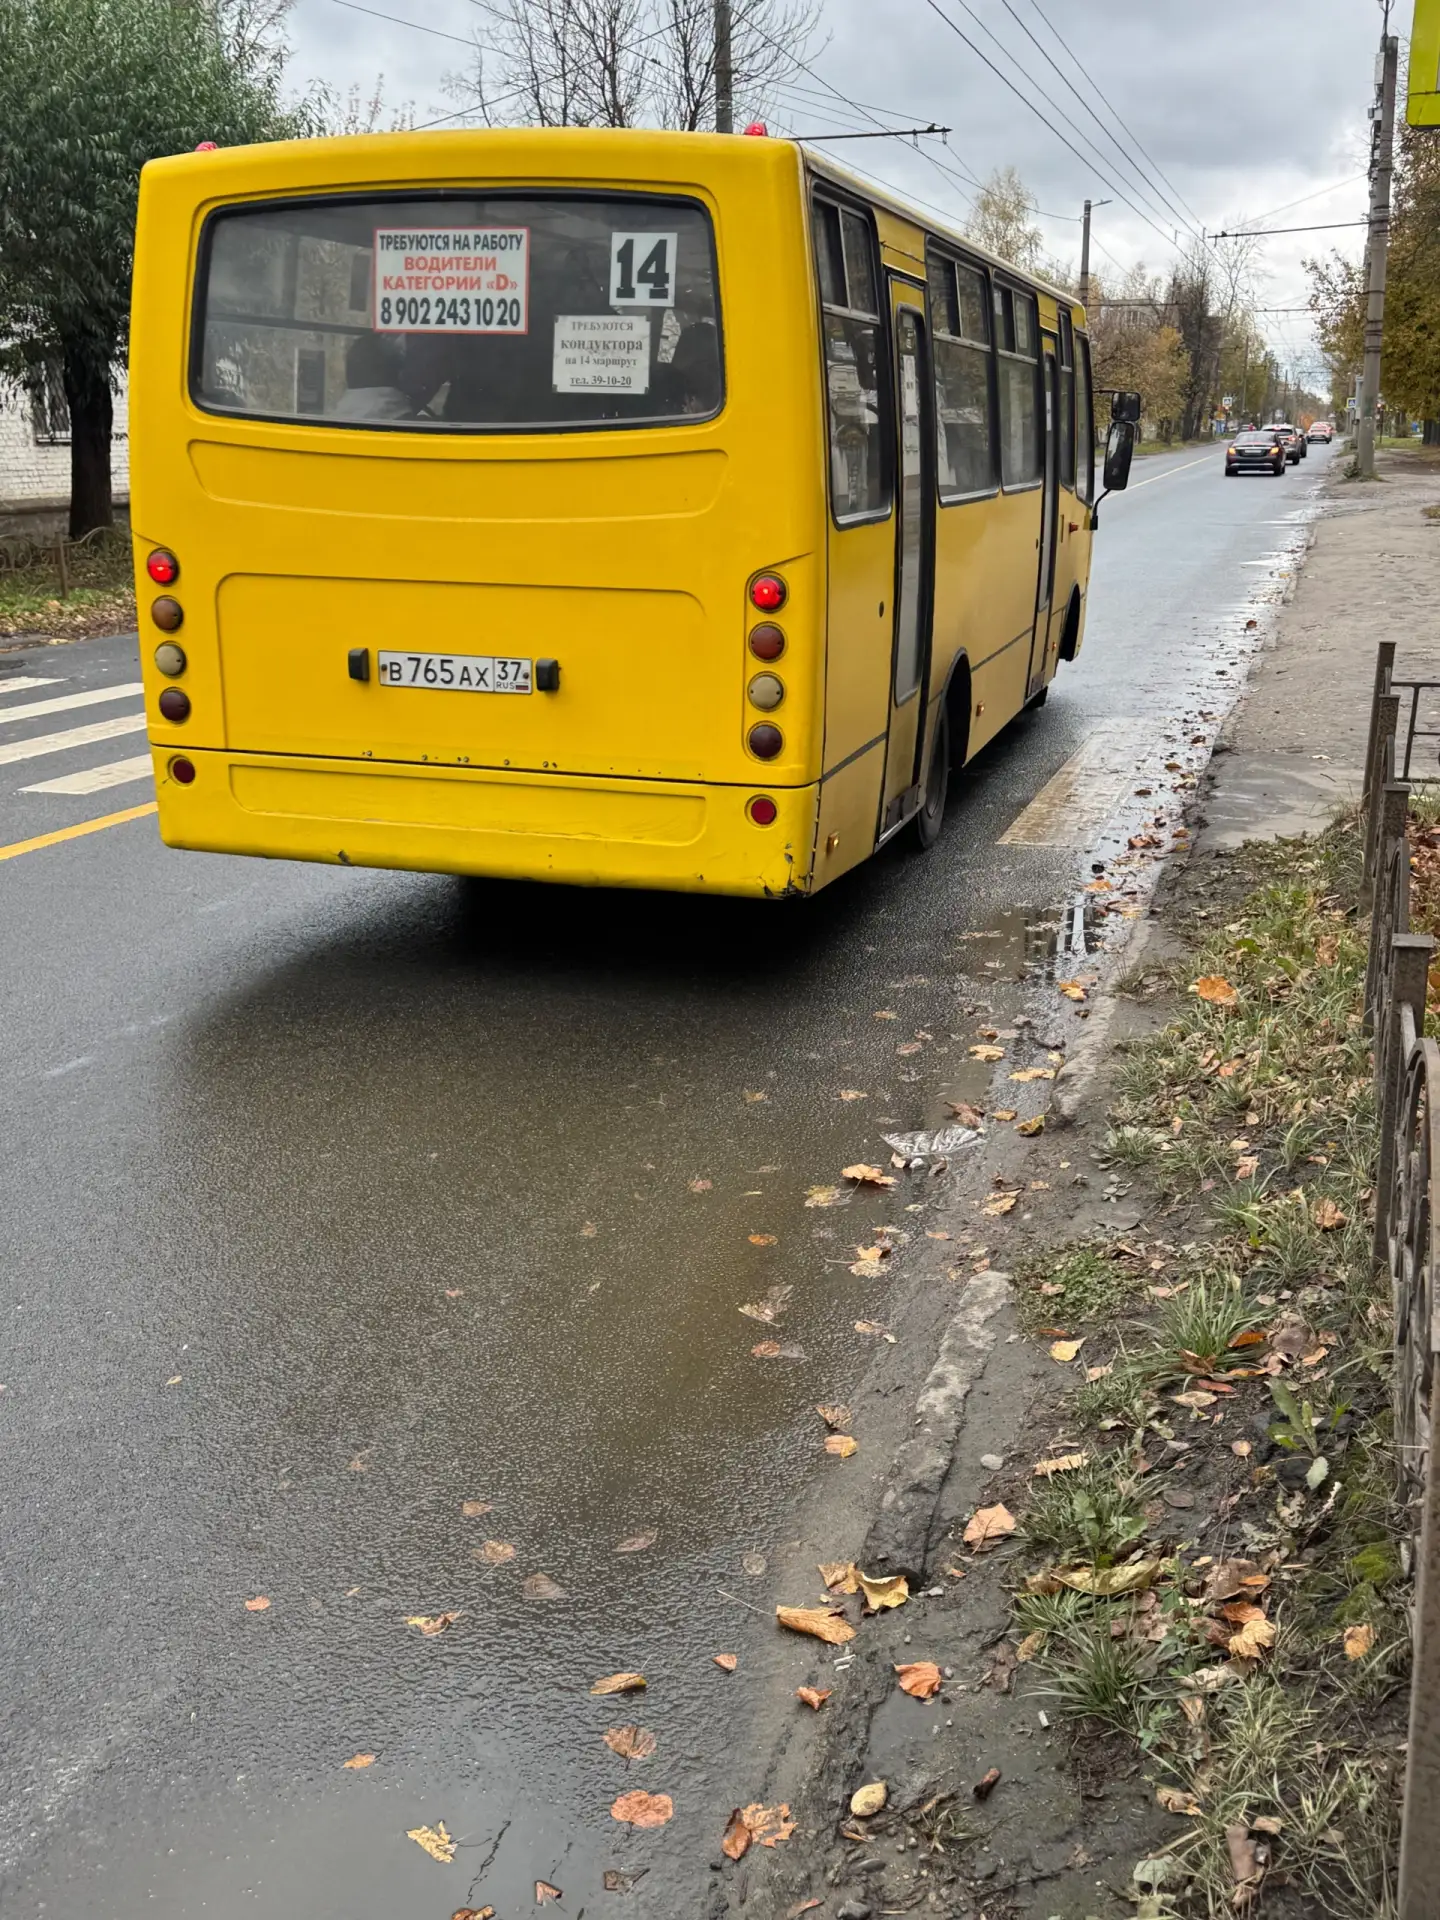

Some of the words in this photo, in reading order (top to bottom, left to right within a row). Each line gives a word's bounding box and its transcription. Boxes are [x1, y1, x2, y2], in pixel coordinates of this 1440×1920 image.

[379, 234, 449, 251] ТРЕБУЮТСЯ
[453, 234, 470, 250] НА
[473, 234, 523, 251] РАБОТУ
[404, 256, 497, 272] ВОДИТЕЛИ
[615, 238, 670, 300] 14
[382, 275, 481, 291] КАТЕГОРИИ
[571, 321, 634, 332] ТРЕБУЮТСЯ
[565, 357, 577, 365] на
[580, 356, 590, 365] 14
[592, 357, 637, 368] маршрут
[570, 377, 589, 385] тел.
[591, 375, 632, 386] 39-10-20
[497, 661, 521, 681] 37
[496, 682, 515, 690] RUS
